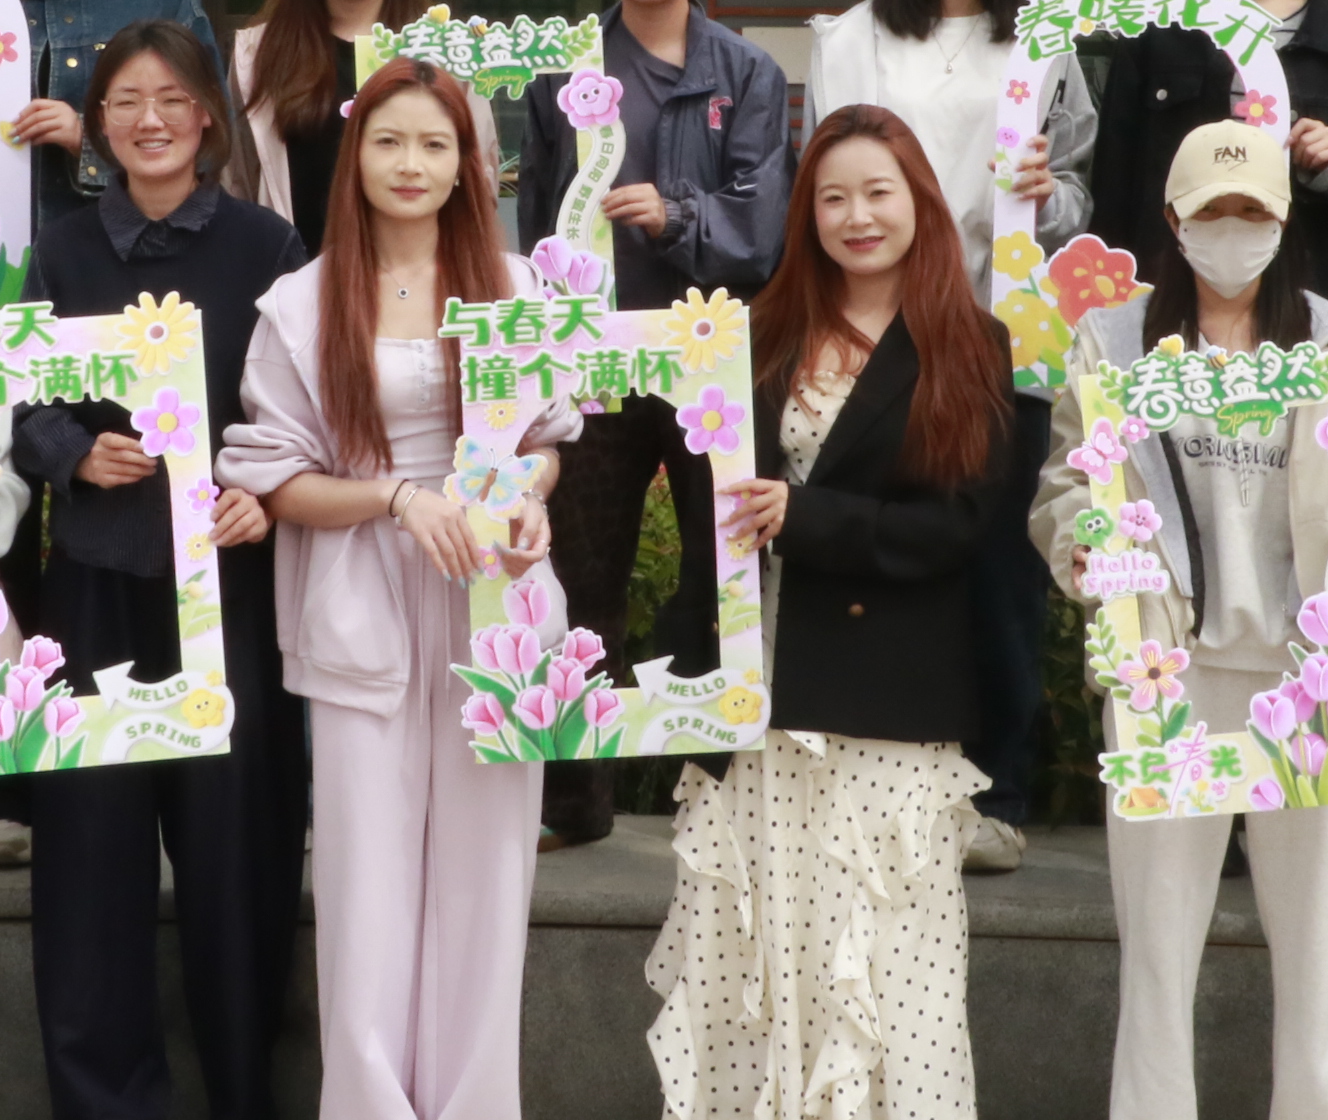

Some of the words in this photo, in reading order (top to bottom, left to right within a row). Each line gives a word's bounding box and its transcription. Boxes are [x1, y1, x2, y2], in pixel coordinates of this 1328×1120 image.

[441, 295, 603, 347] 与春天
[461, 348, 683, 402] 撞个满怀
[1128, 345, 1321, 426] 春意盎然
[1216, 403, 1274, 435] Spring
[1091, 552, 1154, 574] Hello
[1085, 571, 1165, 598] Spring
[128, 680, 189, 702] HELLO
[666, 676, 728, 697] HELLO
[125, 722, 202, 748] SPRING
[663, 715, 738, 745] SPRING
